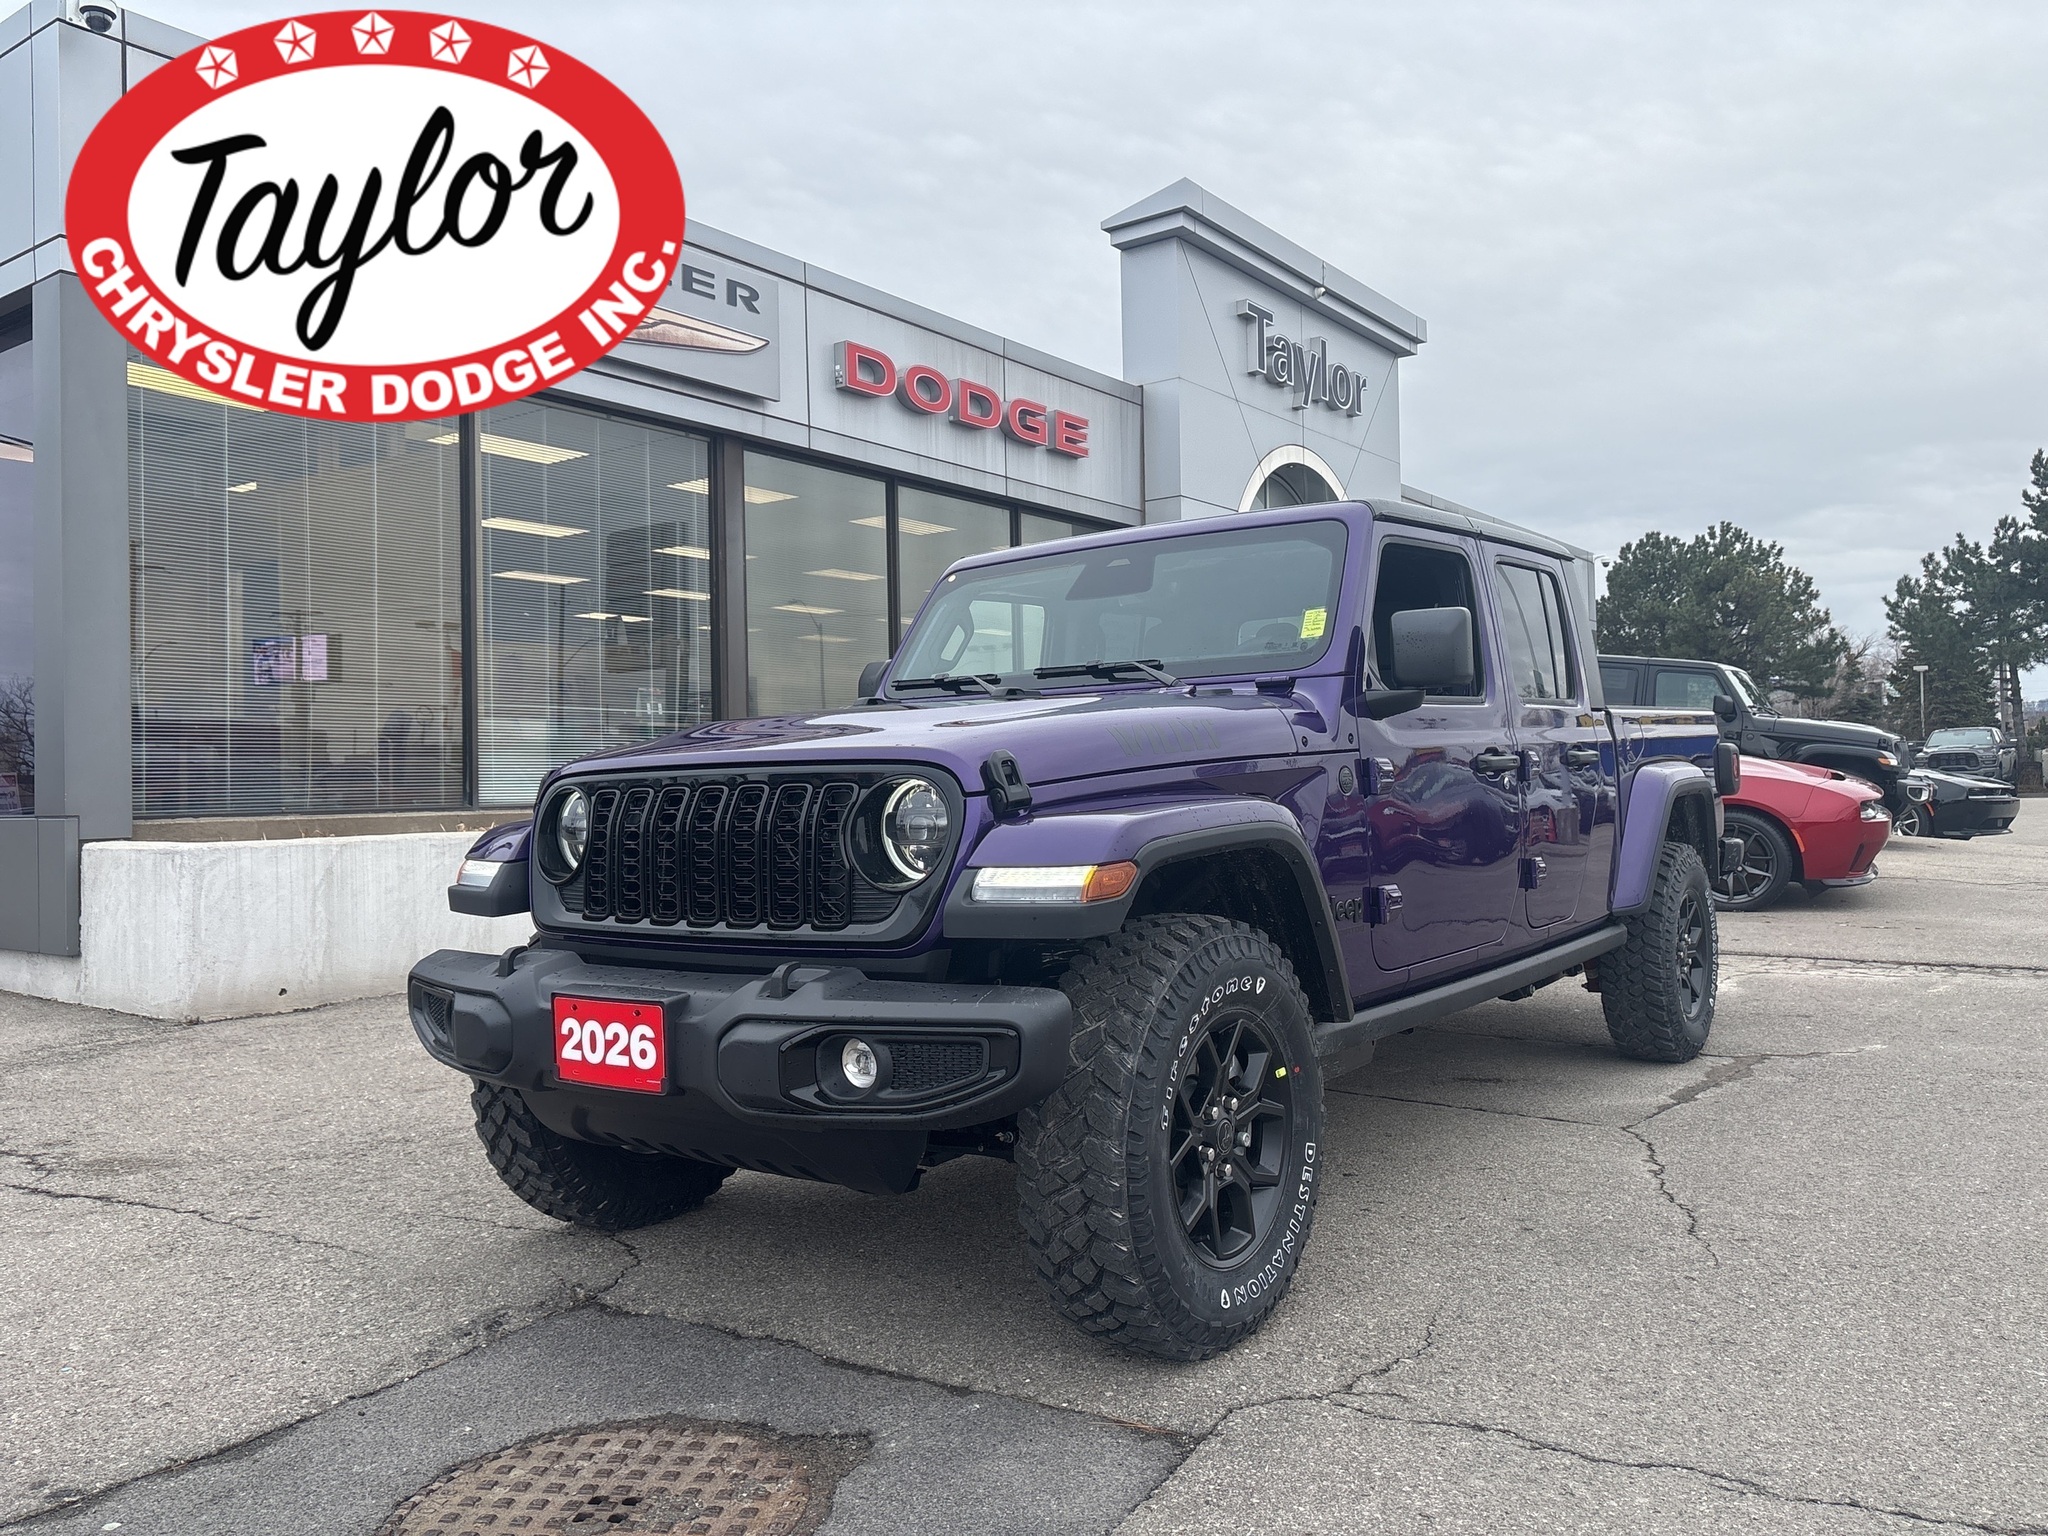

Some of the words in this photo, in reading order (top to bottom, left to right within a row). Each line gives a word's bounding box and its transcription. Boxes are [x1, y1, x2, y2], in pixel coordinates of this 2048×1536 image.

[836, 340, 1090, 459] DODGE
[1238, 299, 1368, 417] Taylor
[1105, 719, 1221, 757] WILLYS
[560, 1017, 657, 1070] 2026
[1160, 975, 1253, 1131] Firestone
[1233, 1142, 1317, 1306] DESTINATION
